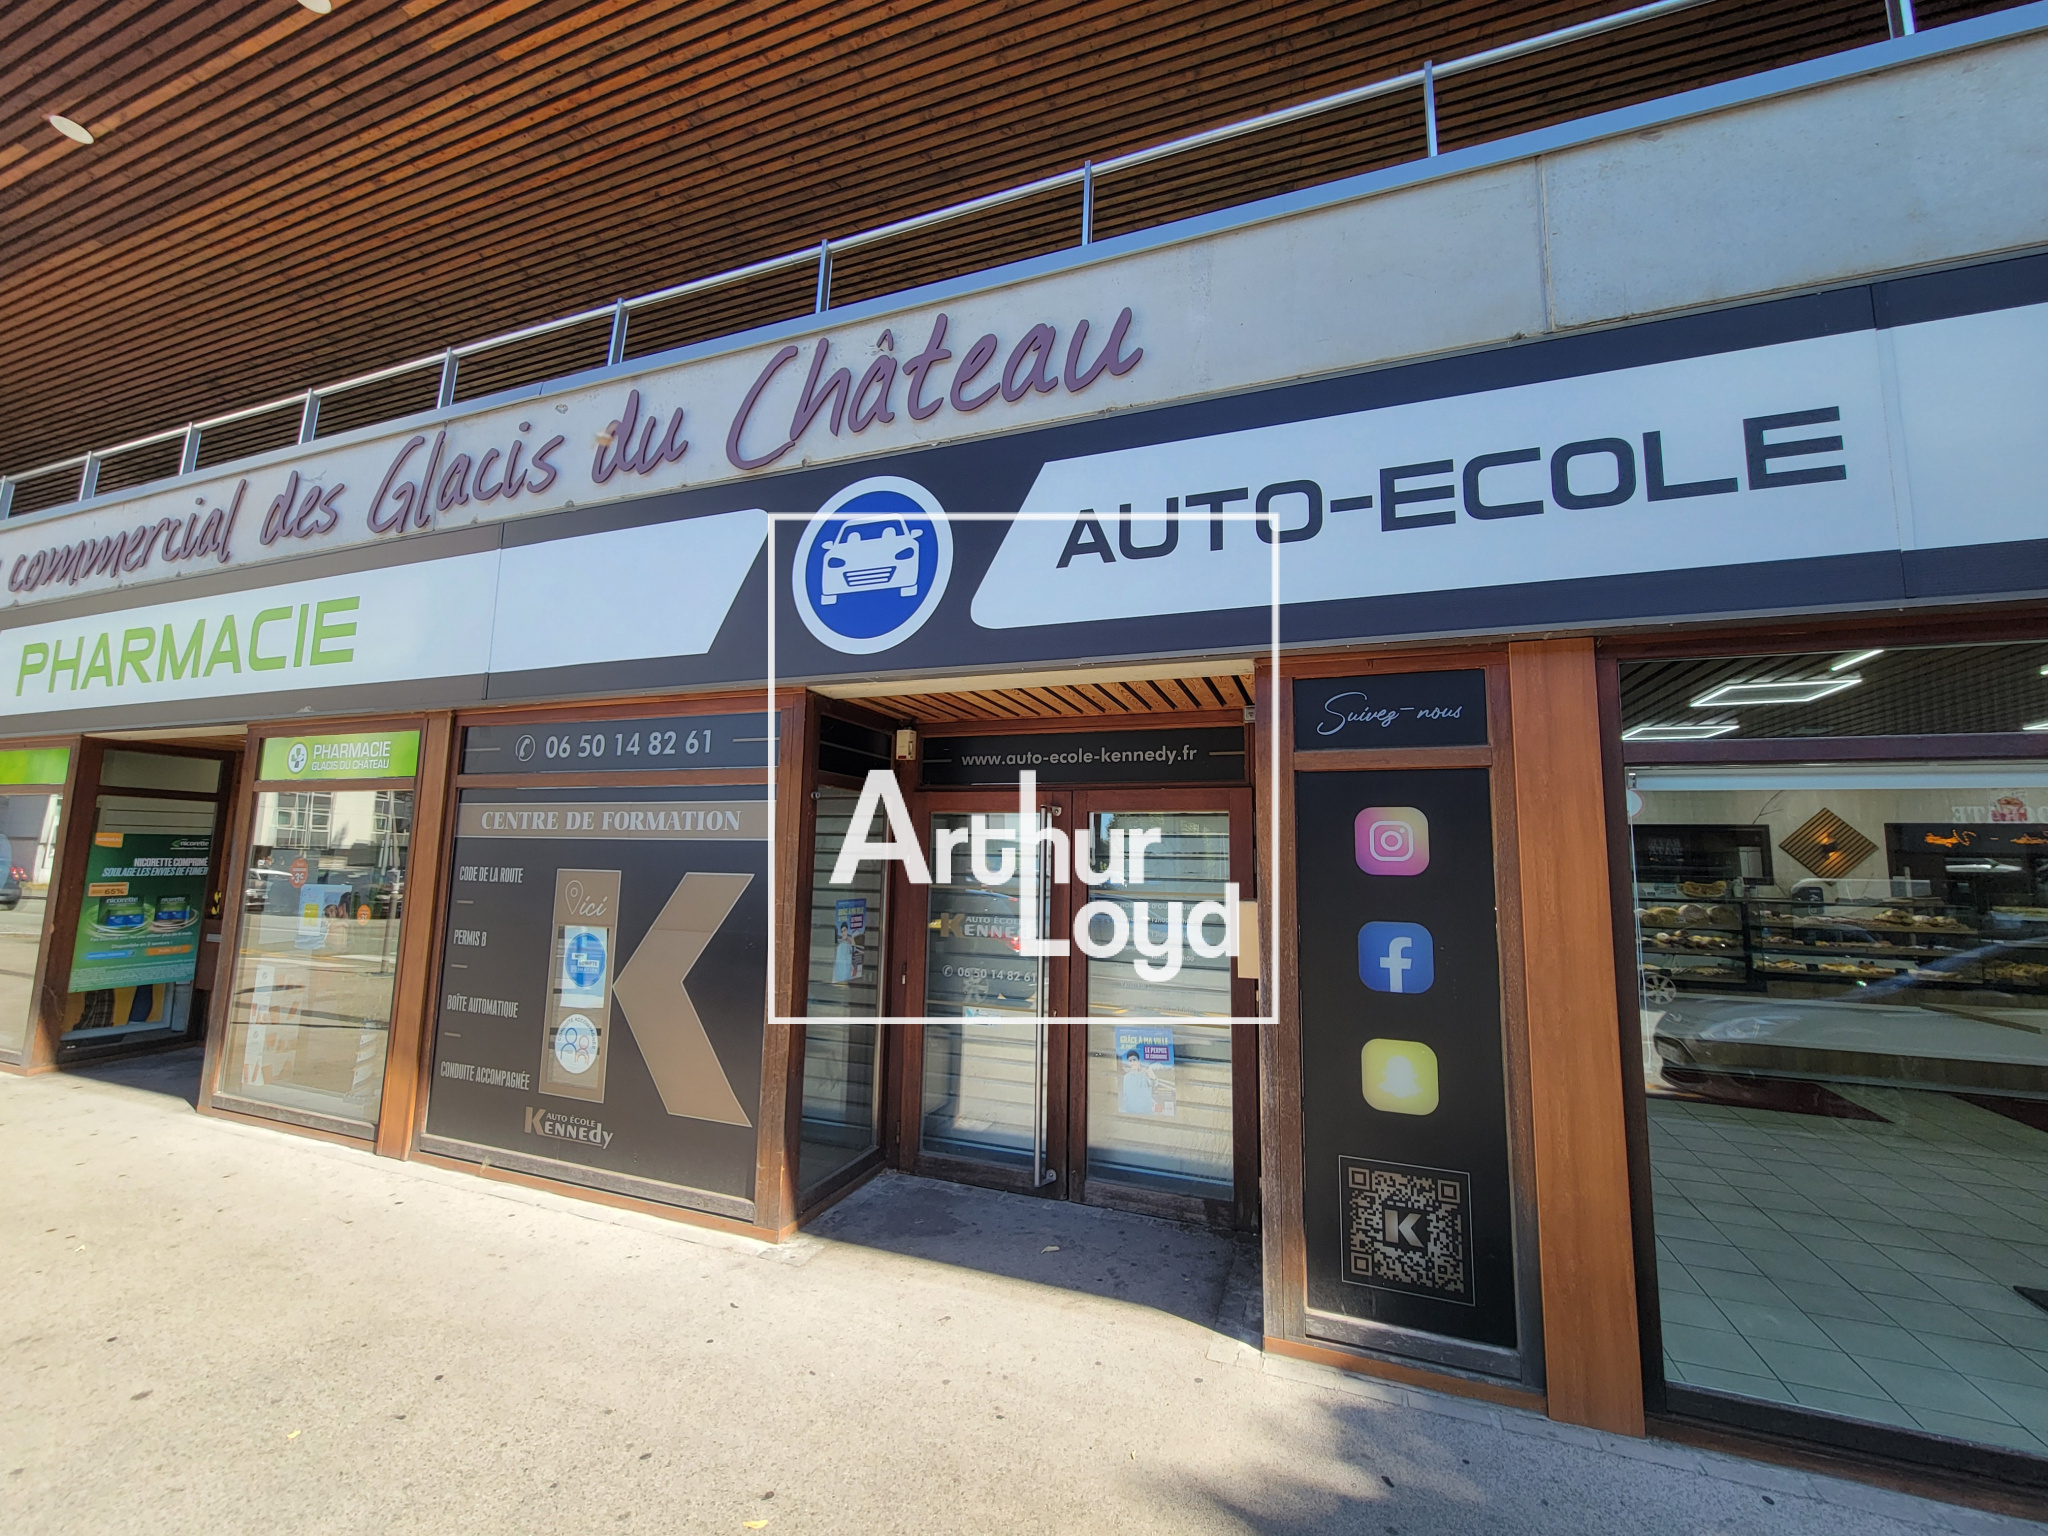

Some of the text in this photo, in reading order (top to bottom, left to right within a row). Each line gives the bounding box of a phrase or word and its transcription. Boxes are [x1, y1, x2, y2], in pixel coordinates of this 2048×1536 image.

[8, 306, 1144, 592] commercial des Glacis du Château
[1056, 406, 1847, 568] AUTO-ECOLE
[16, 595, 361, 696] PHARMACIE
[313, 741, 392, 760] PHARMACIE
[545, 729, 712, 758] 06 50 14 82 61
[311, 757, 390, 771] GLACIS DU CHÂTEAU
[961, 745, 1197, 765] www.auto-ecole-kennedy.fr
[481, 810, 742, 831] CENTRE DE FORMATION
[102, 867, 136, 877] SOULAGE
[133, 858, 173, 867] NICORETTE
[459, 866, 524, 883] CODE DE LA ROUTE
[966, 916, 1023, 925] AUTO ÉCOL
[453, 929, 487, 947] PERMIS B
[957, 967, 1036, 983] 06 50 14 82 61
[447, 993, 519, 1018] BOÎTE AUTOMATIQUE
[440, 1061, 530, 1090] CONDUITE ACCOMPAGNÉE
[546, 1112, 596, 1127] AUTO ÉCOLE
